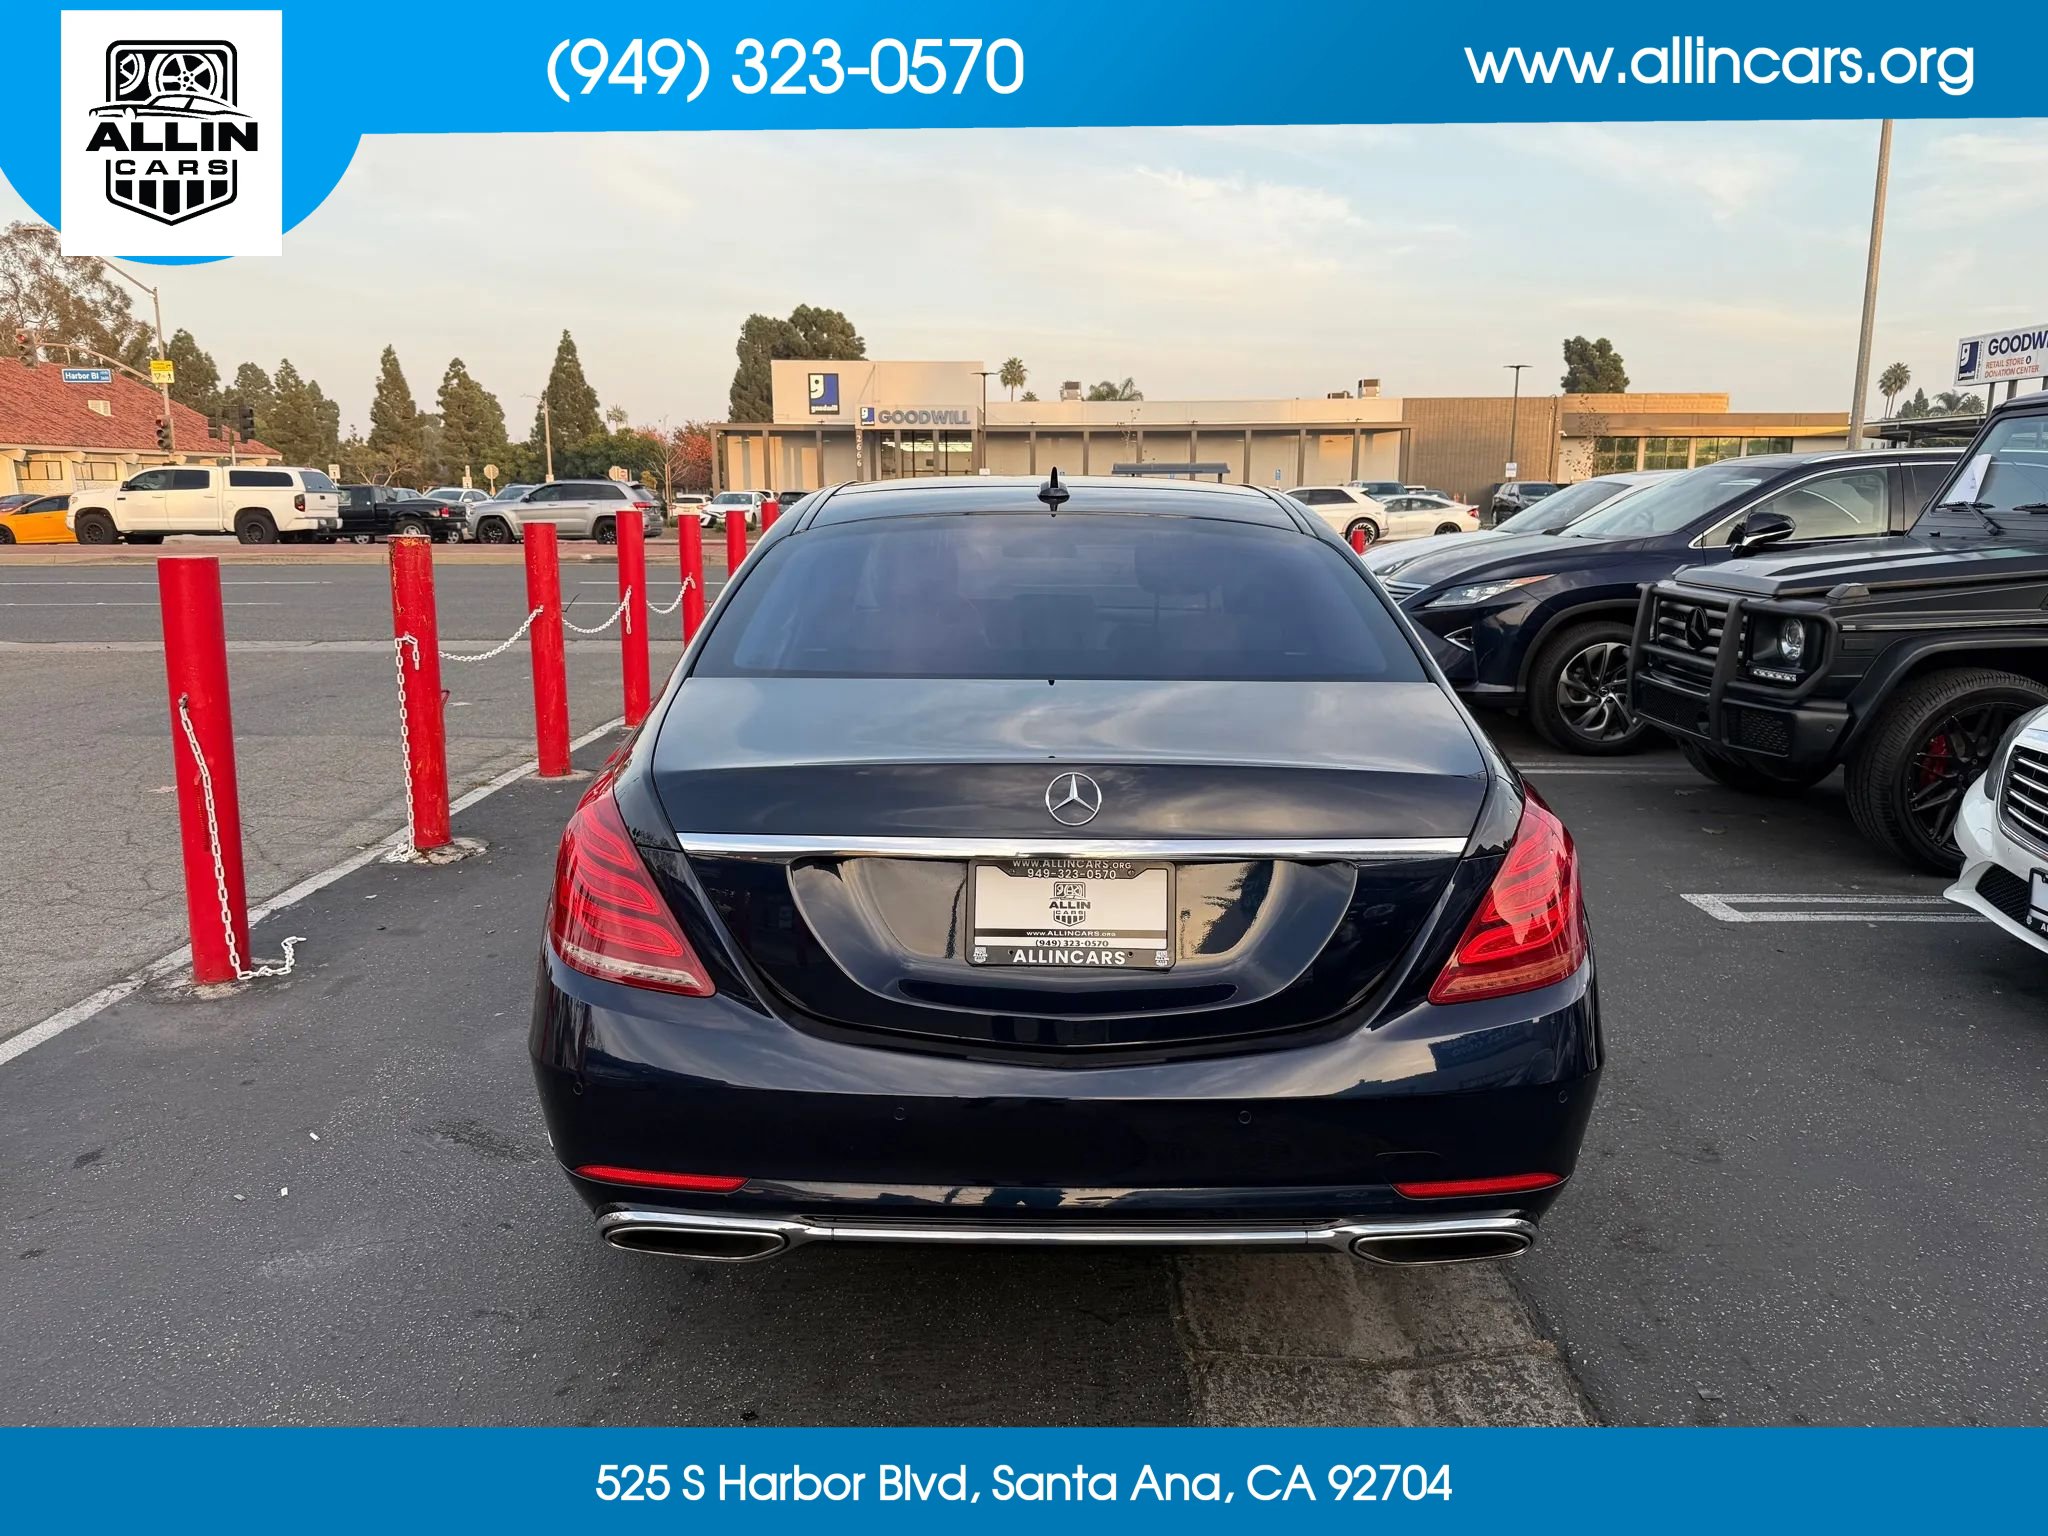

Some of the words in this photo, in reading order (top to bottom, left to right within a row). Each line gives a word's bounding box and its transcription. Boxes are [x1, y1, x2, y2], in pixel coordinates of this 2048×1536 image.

[1988, 330, 2048, 356] GOODW
[1986, 361, 2005, 369] RETAIL
[2005, 357, 2024, 367] STORE
[65, 371, 90, 380] Harbor
[1984, 368, 2015, 378] DONATION
[2016, 365, 2040, 375] CENTER
[878, 410, 971, 425] GOODWILL
[1027, 868, 1117, 879] 949-323-0570
[1049, 901, 1091, 909] ALLIN
[1012, 949, 1126, 965] ALLINCARS
